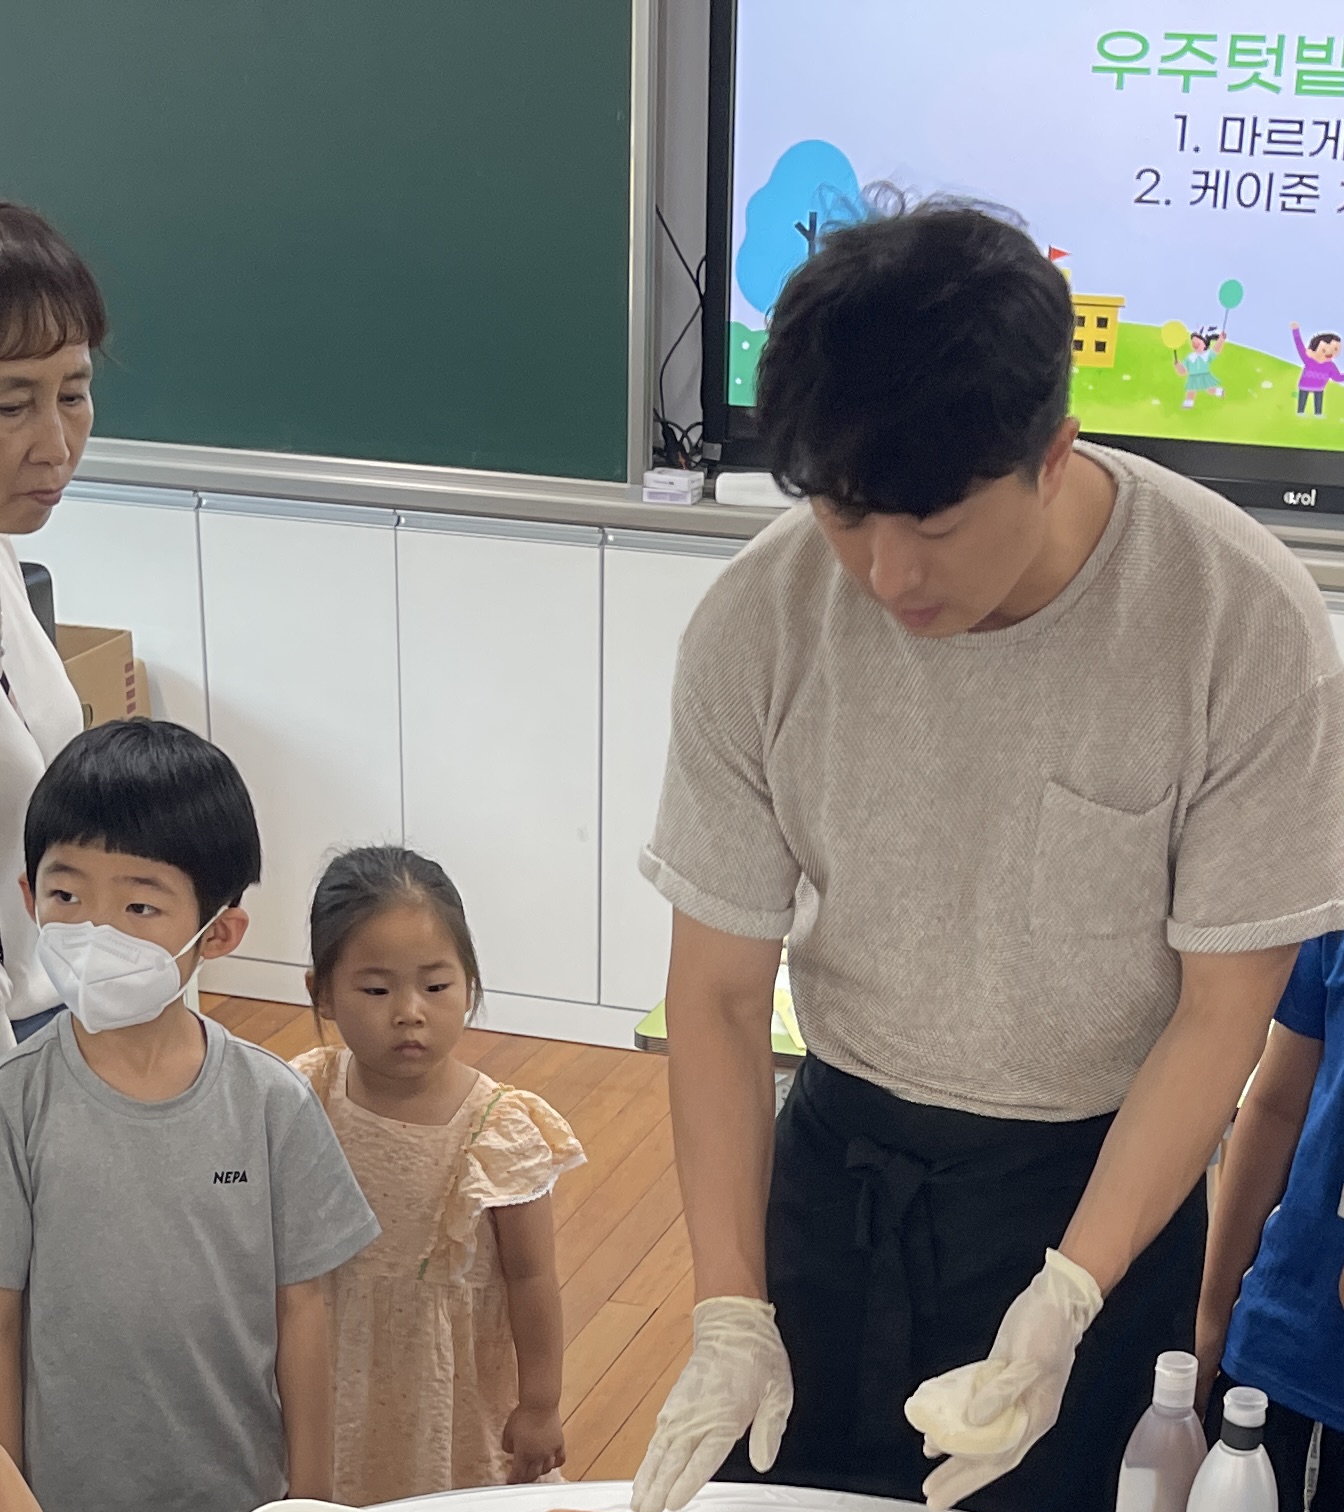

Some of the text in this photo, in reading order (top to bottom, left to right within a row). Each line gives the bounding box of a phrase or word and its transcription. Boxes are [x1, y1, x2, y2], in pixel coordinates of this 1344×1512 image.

[1174, 114, 1200, 152] 1.
[1133, 168, 1171, 206] 2.
[1189, 169, 1320, 214] 케이준
[212, 1170, 248, 1185] NEPA
